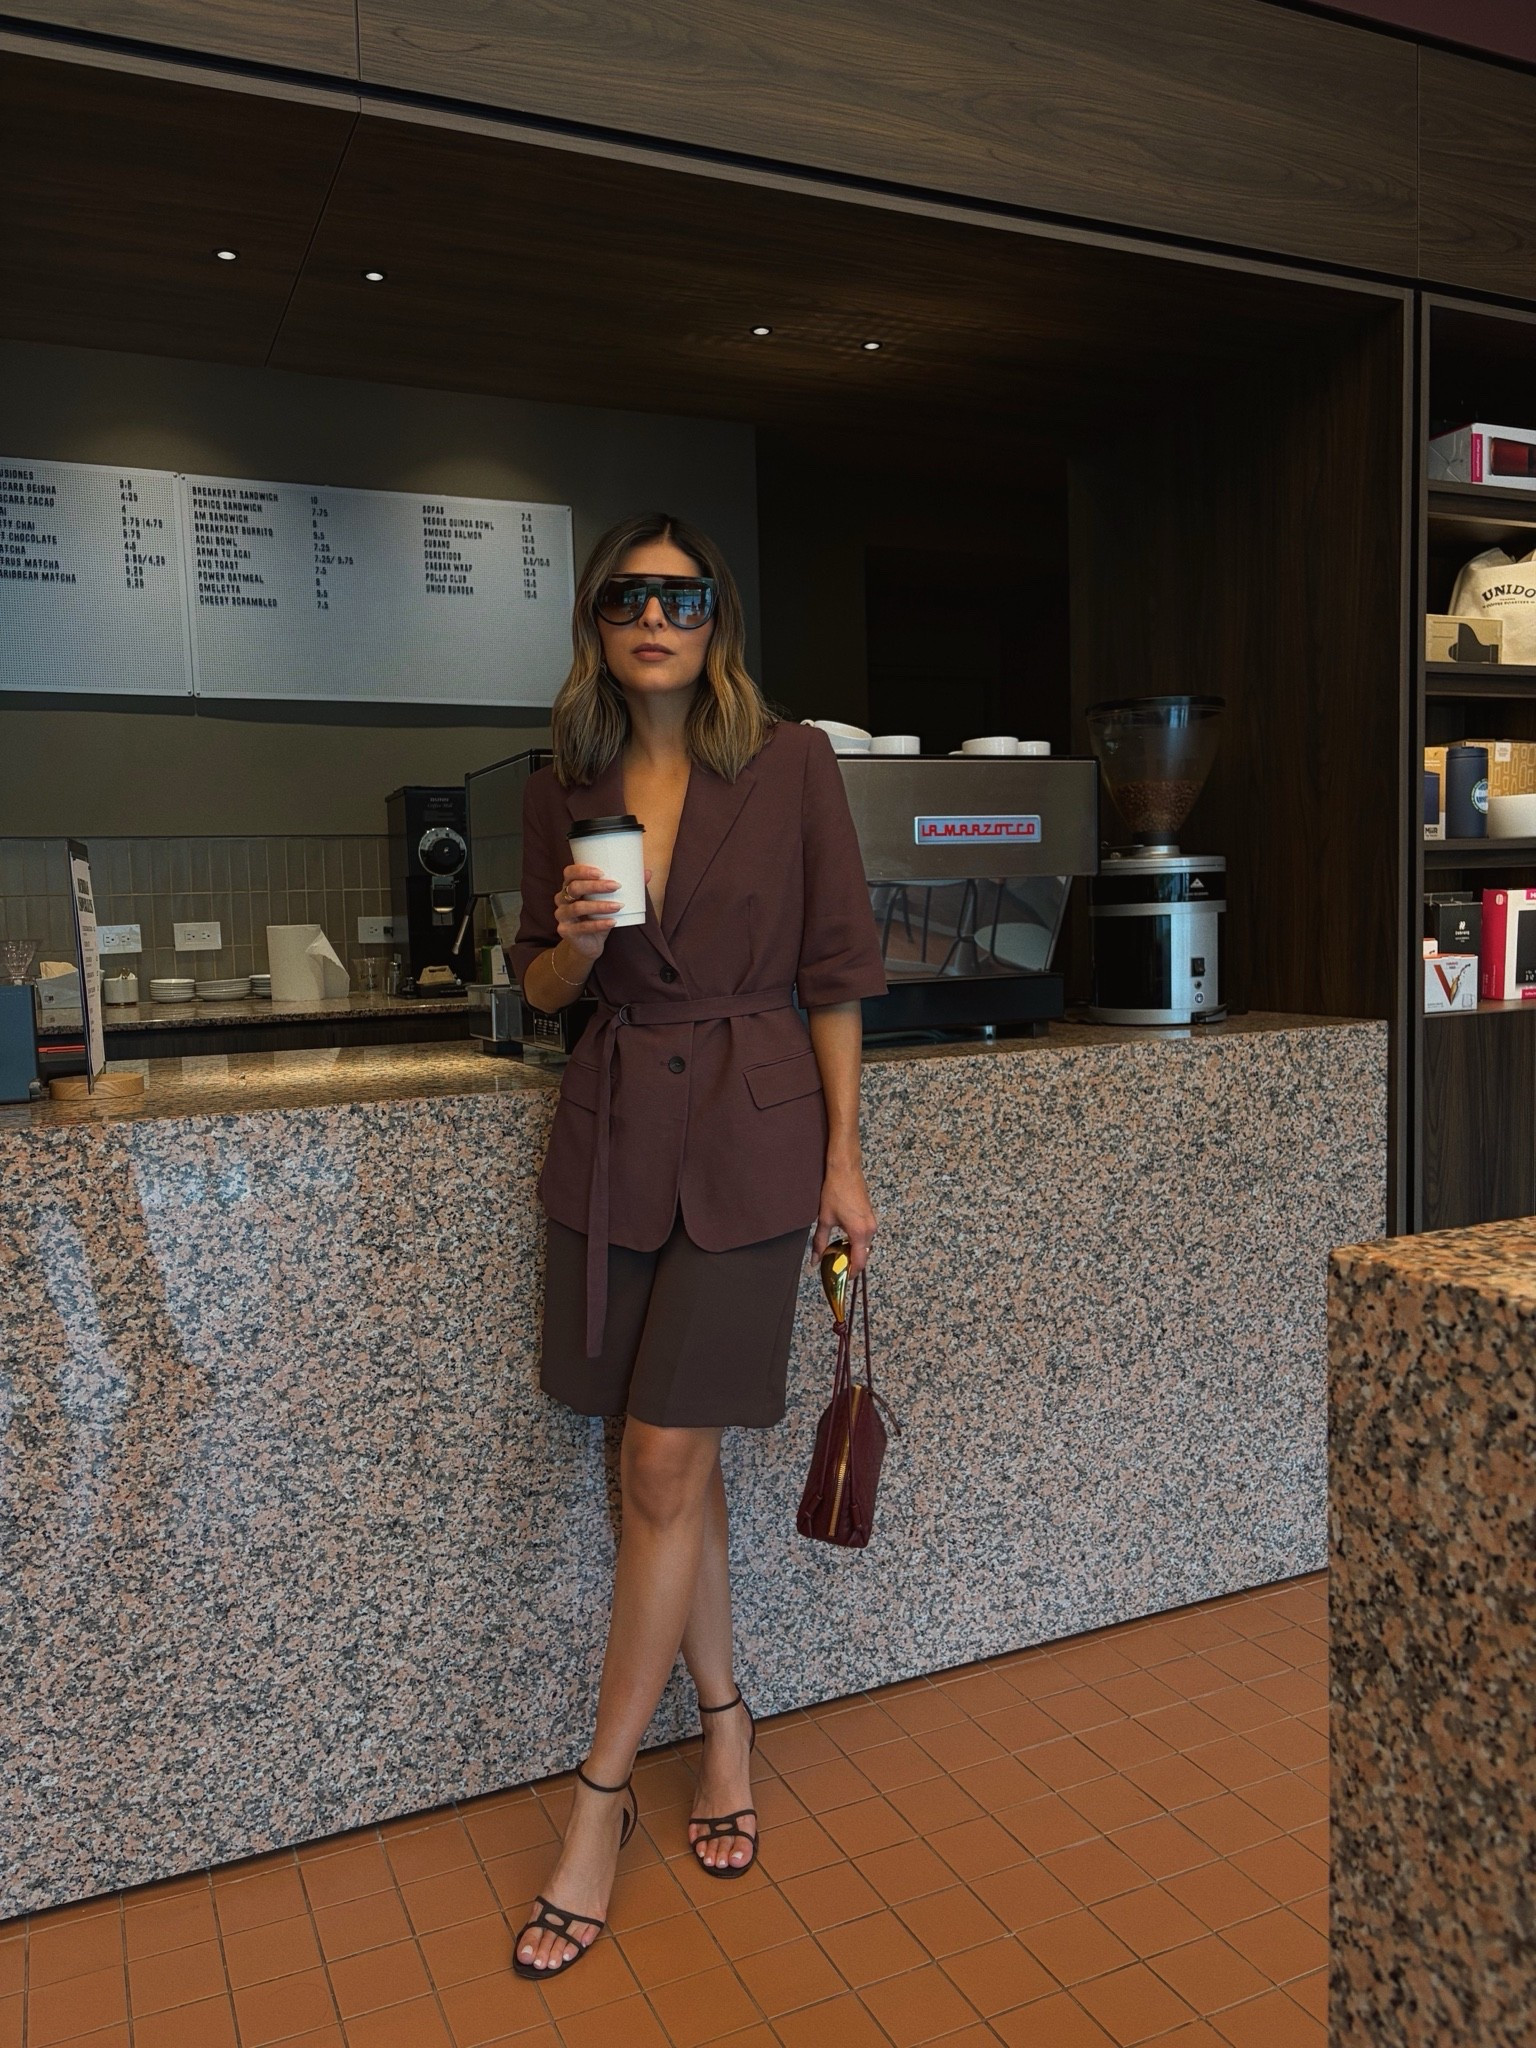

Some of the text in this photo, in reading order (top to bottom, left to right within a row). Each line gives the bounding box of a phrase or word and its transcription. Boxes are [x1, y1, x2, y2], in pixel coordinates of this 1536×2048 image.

[27, 483, 57, 495] GEISHA
[192, 486, 279, 502] BREAKFAST SANDWICH
[27, 495, 55, 507] CACAO
[193, 498, 263, 513] PERICO SANDWICH
[310, 496, 318, 505] 10
[194, 510, 249, 523] AM SANDWICH
[312, 507, 328, 518] 7.75
[422, 505, 444, 516] SOPAS
[16, 520, 35, 531] CHAI
[195, 522, 274, 537] BREAKFAST BURRITO
[422, 516, 495, 531] VEGGIE QUINOA BOWL
[9, 532, 58, 545] CHOCOLATE
[195, 534, 238, 547] ACAI BOWL
[424, 528, 483, 540] SMOKED SALMON
[314, 543, 330, 553] 7.25
[424, 539, 450, 550] CUBANO
[196, 546, 251, 559] ARMA TU ACAI
[24, 558, 60, 570] MATCHA
[197, 559, 239, 571] AVO TOAST
[425, 561, 473, 574] CAESAR WRAP
[41, 571, 77, 584] MATCHA
[198, 570, 264, 584] POWER OATMEAL
[426, 572, 467, 585] POLLO CLUB
[198, 582, 241, 595] OMELETTA
[448, 585, 474, 597] BURGER
[1481, 584, 1536, 602] UNIDO
[200, 594, 277, 608] CHEESY SCRAMBLED
[921, 823, 1036, 837] LA MARZOCCO
